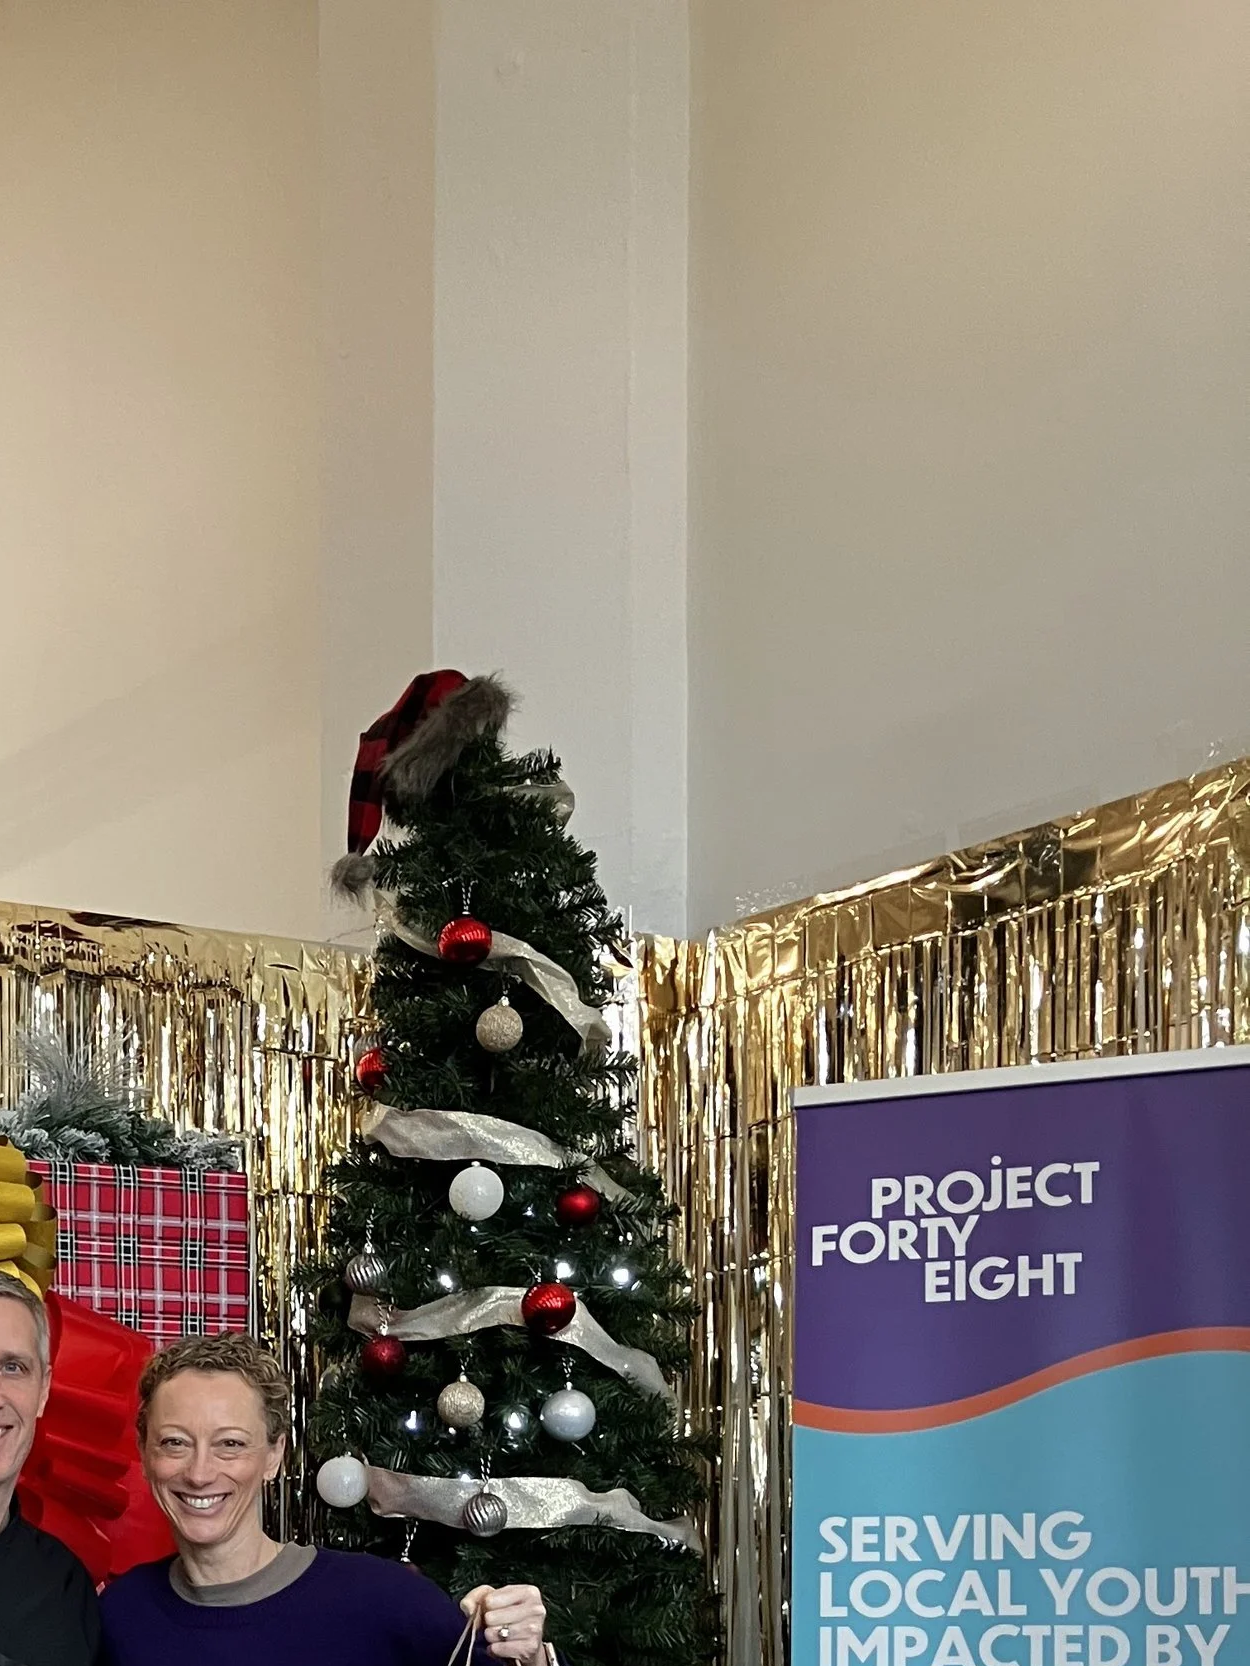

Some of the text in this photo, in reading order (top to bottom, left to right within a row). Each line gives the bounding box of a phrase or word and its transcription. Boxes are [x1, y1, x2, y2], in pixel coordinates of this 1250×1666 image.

[811, 1214, 979, 1267] FORTY
[924, 1252, 1083, 1303] EIGHT
[817, 1510, 1092, 1563] SERVING
[819, 1568, 1028, 1618] LOCAL
